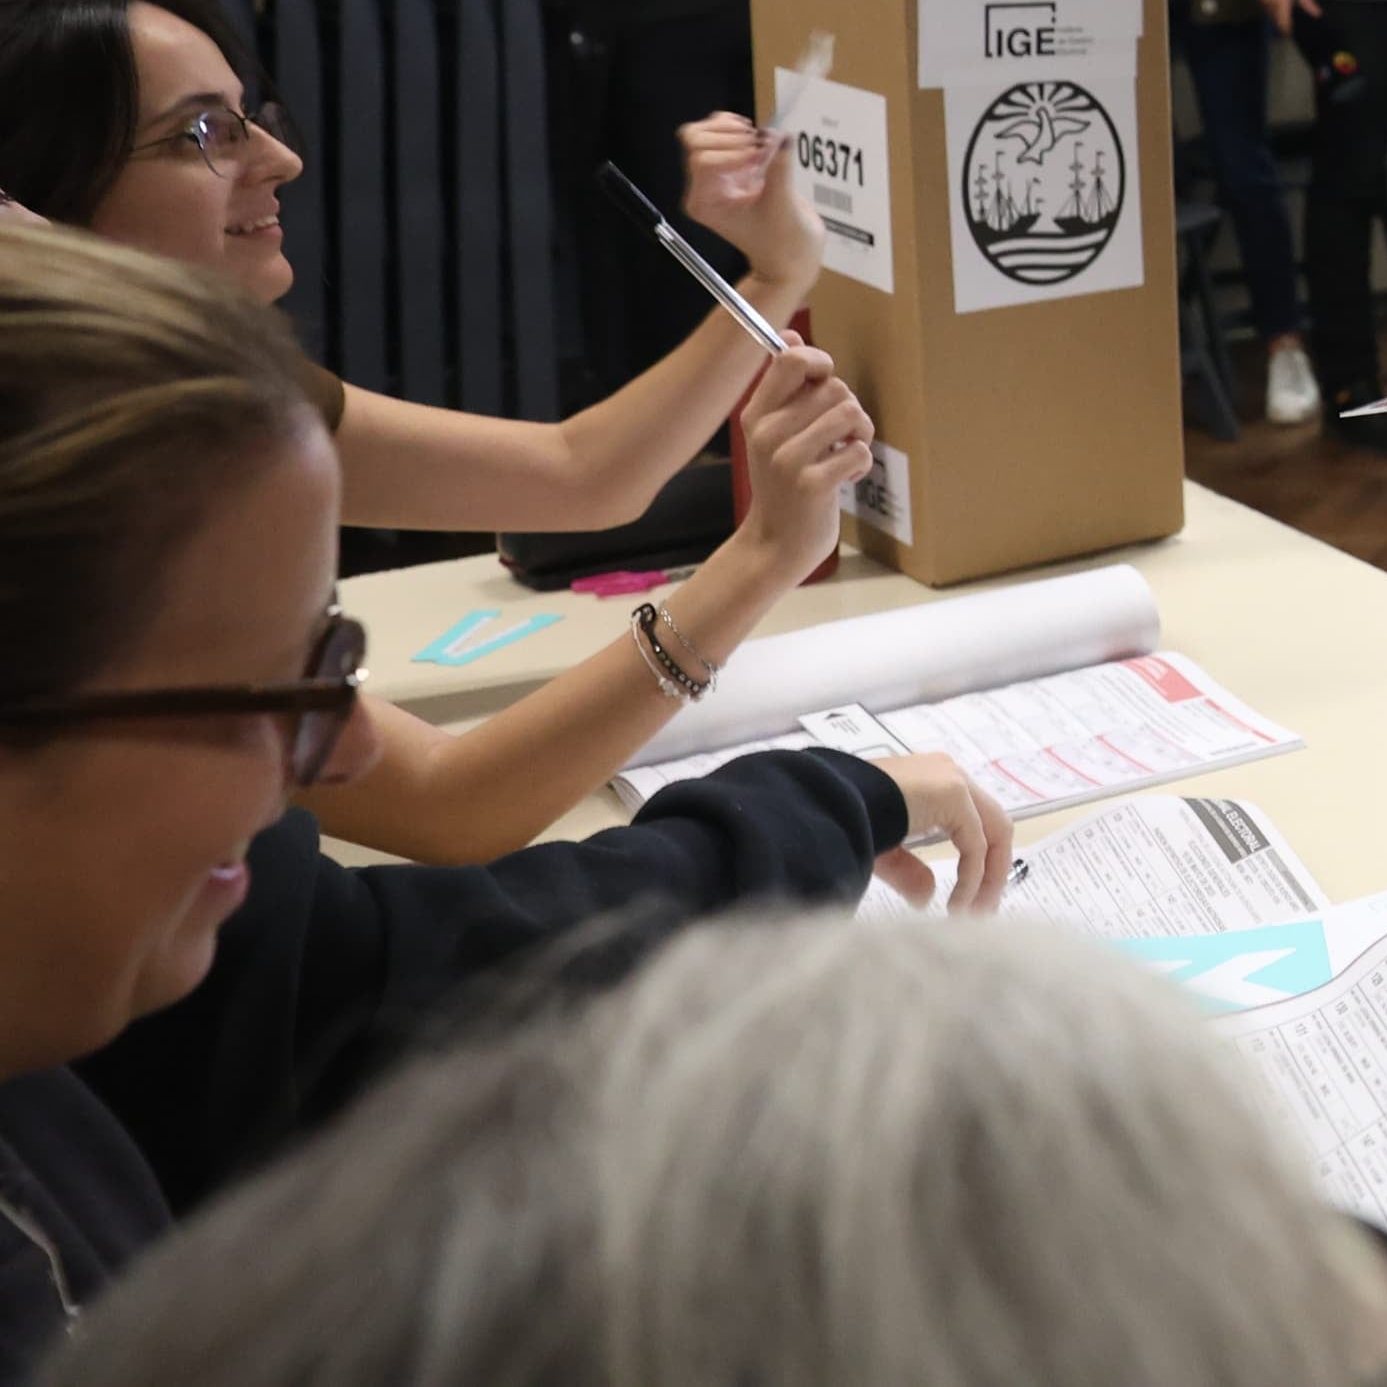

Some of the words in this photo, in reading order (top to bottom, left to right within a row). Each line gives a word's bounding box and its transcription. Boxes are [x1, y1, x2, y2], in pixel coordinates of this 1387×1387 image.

[997, 27, 1056, 57] IGE
[798, 131, 865, 188] 06371
[1225, 809, 1261, 853] ELECTORAL
